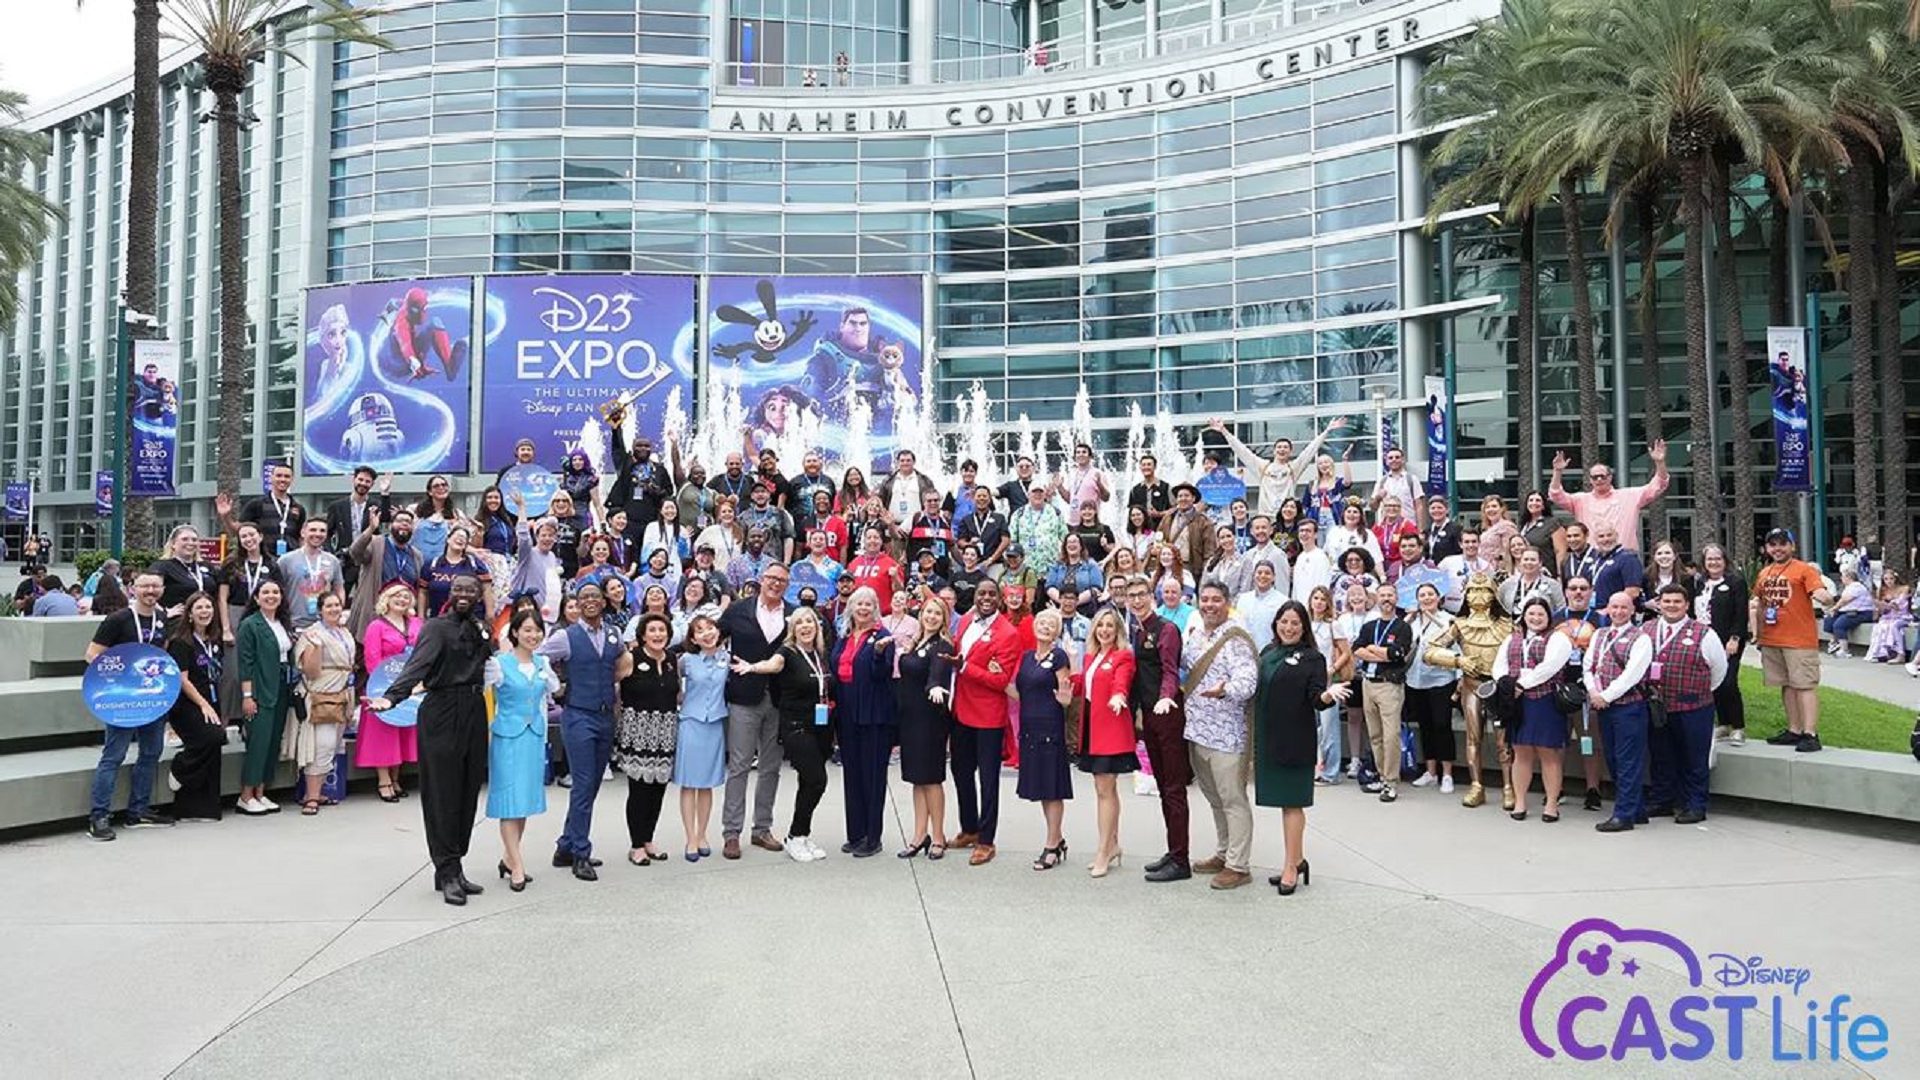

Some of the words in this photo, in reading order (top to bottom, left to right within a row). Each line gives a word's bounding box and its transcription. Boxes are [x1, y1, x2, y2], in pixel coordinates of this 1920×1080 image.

[729, 110, 907, 131] ANAHEIM
[946, 71, 1215, 126] CONVENTION
[1256, 17, 1420, 80] CENTER
[533, 287, 634, 333] D23
[517, 340, 657, 380] EXPO
[522, 399, 562, 417] Disney
[566, 402, 594, 412] FAN
[534, 387, 560, 397] THE
